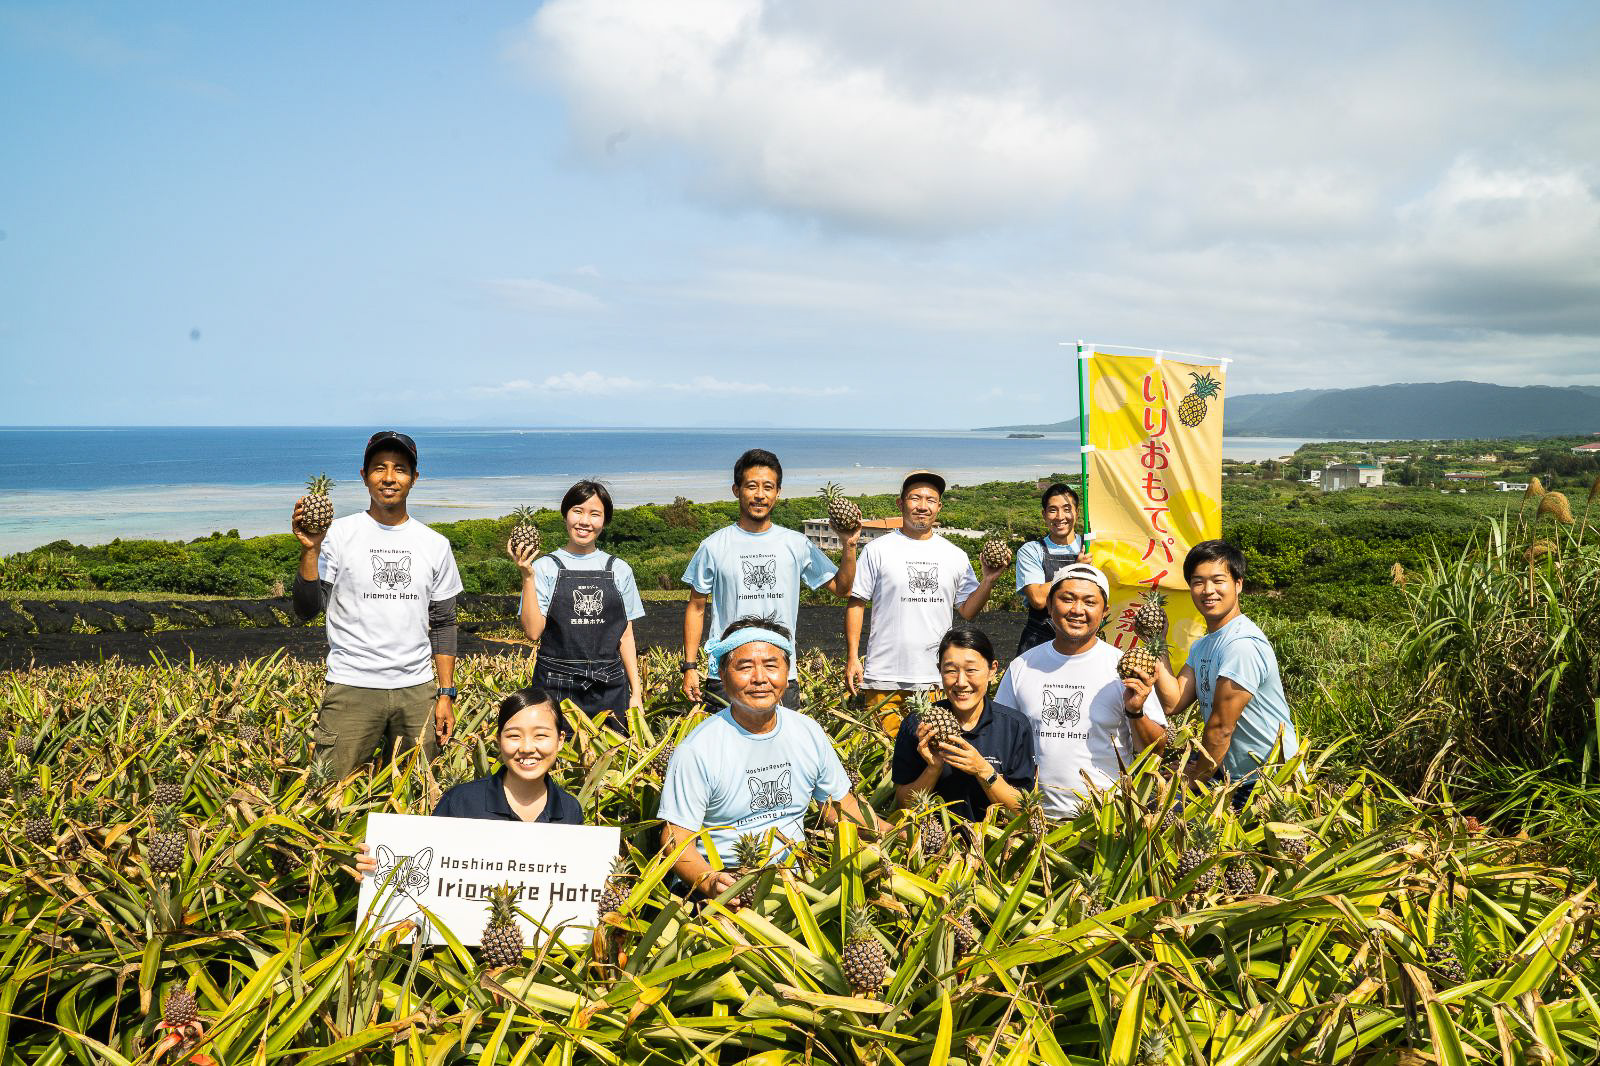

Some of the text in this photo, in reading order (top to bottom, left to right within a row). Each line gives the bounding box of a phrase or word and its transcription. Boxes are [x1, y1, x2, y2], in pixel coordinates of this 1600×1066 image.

[1113, 374, 1175, 650] いりおもてパイ祭り
[440, 856, 568, 874] Hoshino Resorts
[549, 882, 602, 903] Hote
